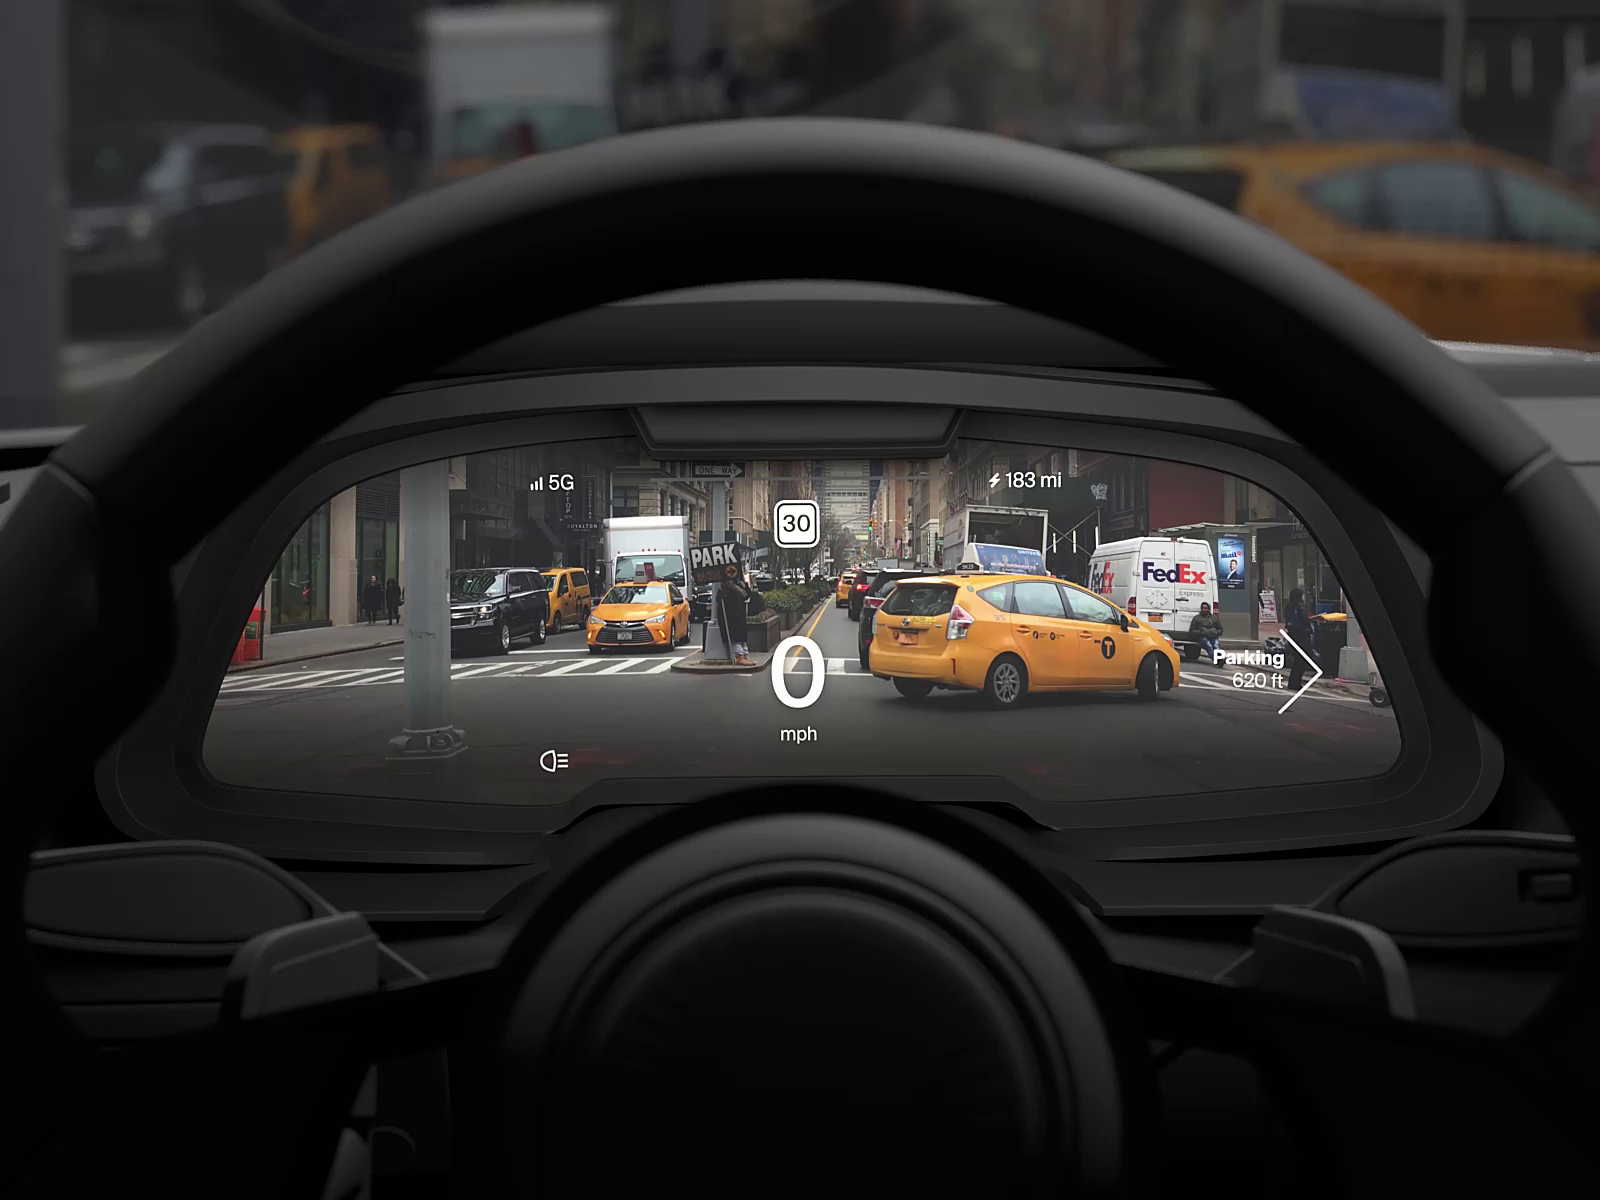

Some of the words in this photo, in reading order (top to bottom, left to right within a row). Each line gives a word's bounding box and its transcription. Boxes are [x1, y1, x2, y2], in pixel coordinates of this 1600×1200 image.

[699, 466, 715, 474] ONE
[721, 467, 738, 475] WAY
[1005, 471, 1036, 488] 183
[1040, 471, 1062, 488] mi
[548, 474, 574, 491] 5G
[783, 514, 811, 533] 30
[690, 543, 738, 569] PARK
[1143, 561, 1206, 585] FedEx
[1178, 590, 1204, 598] Express
[1213, 650, 1285, 669] Parking
[771, 635, 826, 709] 0
[1232, 672, 1267, 689] 620
[1271, 672, 1284, 689] ft
[780, 725, 818, 745] mph
